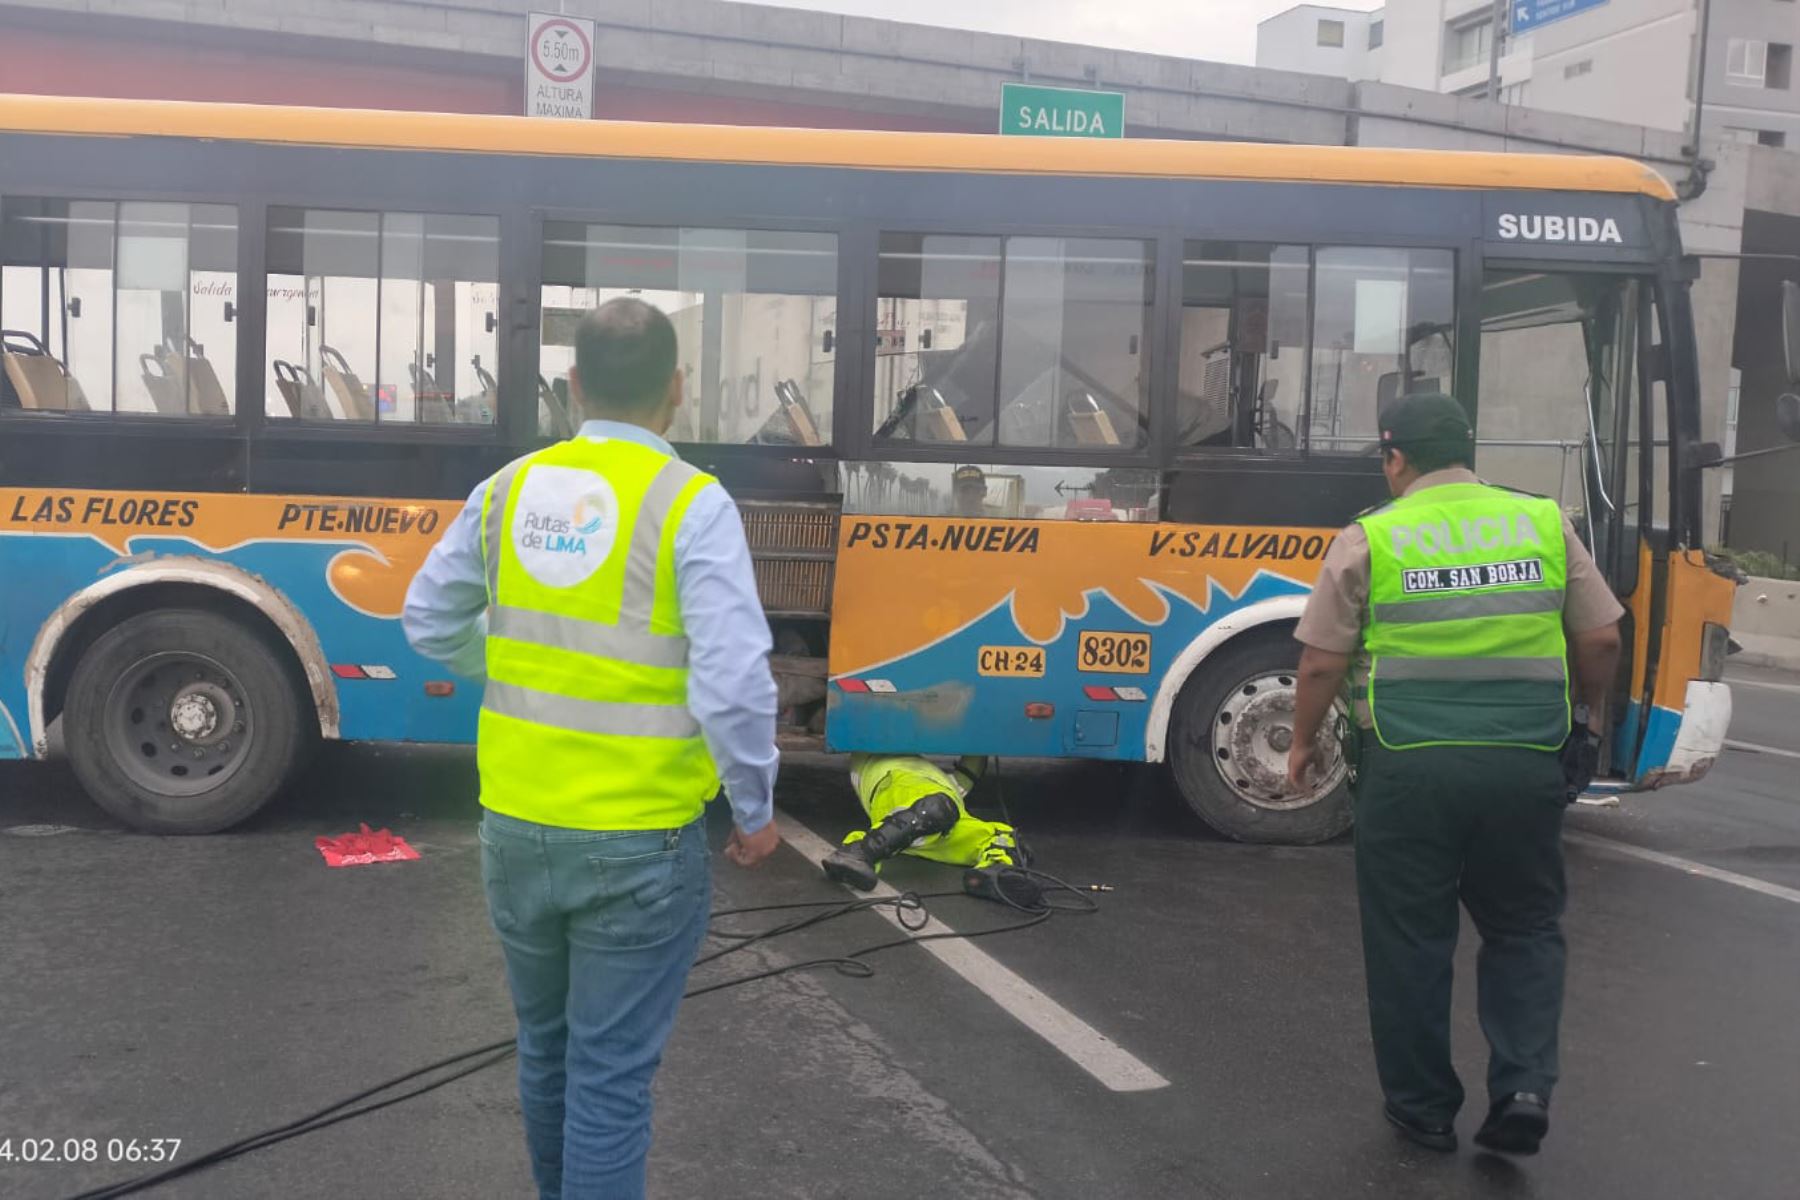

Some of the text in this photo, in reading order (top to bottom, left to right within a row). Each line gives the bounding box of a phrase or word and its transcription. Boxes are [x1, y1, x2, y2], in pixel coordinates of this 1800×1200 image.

[543, 40, 580, 61] 5.50m
[537, 84, 584, 102] ALTURA
[536, 102, 584, 118] MAXIMA
[1018, 106, 1105, 134] SALIDA
[1498, 213, 1623, 243] SUBIDA
[11, 496, 199, 527] LAS FLORES
[524, 512, 570, 534] Rutas
[521, 531, 587, 556] de LIMA
[847, 522, 1040, 553] PSTA.NUEVA
[1391, 512, 1540, 559] POLICIA
[1407, 562, 1539, 590] COM. SAN BORJA
[1083, 636, 1149, 668] 8302
